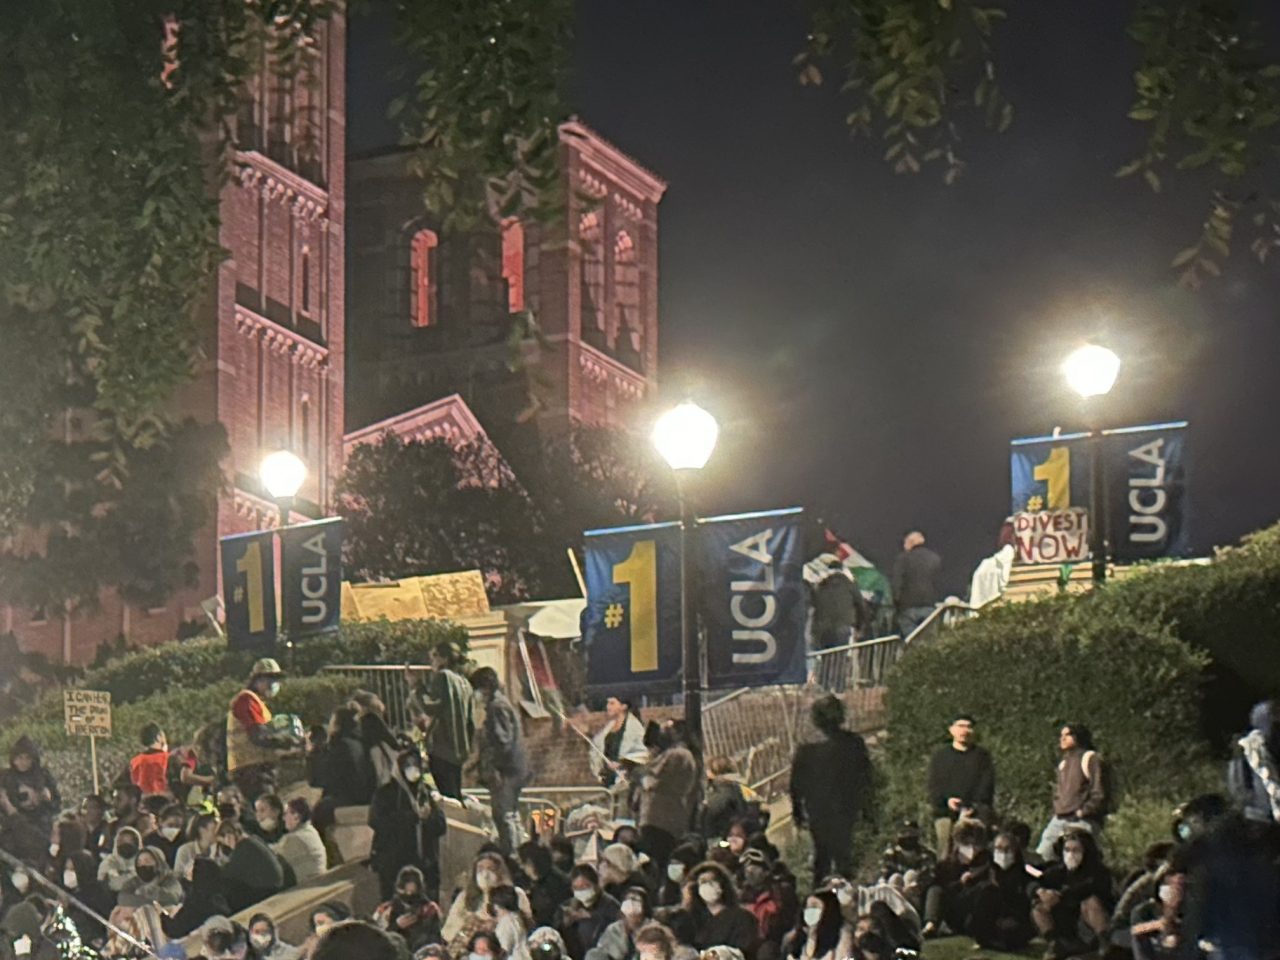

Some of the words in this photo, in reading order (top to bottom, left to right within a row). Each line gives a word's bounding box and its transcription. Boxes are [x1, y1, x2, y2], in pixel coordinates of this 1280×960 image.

[1017, 512, 1085, 532] DIVEST
[1129, 437, 1166, 542] UCLA
[233, 542, 265, 633] #1
[301, 531, 327, 624] UCLA
[1015, 533, 1084, 560] NOW
[604, 540, 658, 673] #1
[728, 528, 777, 664] UCLA
